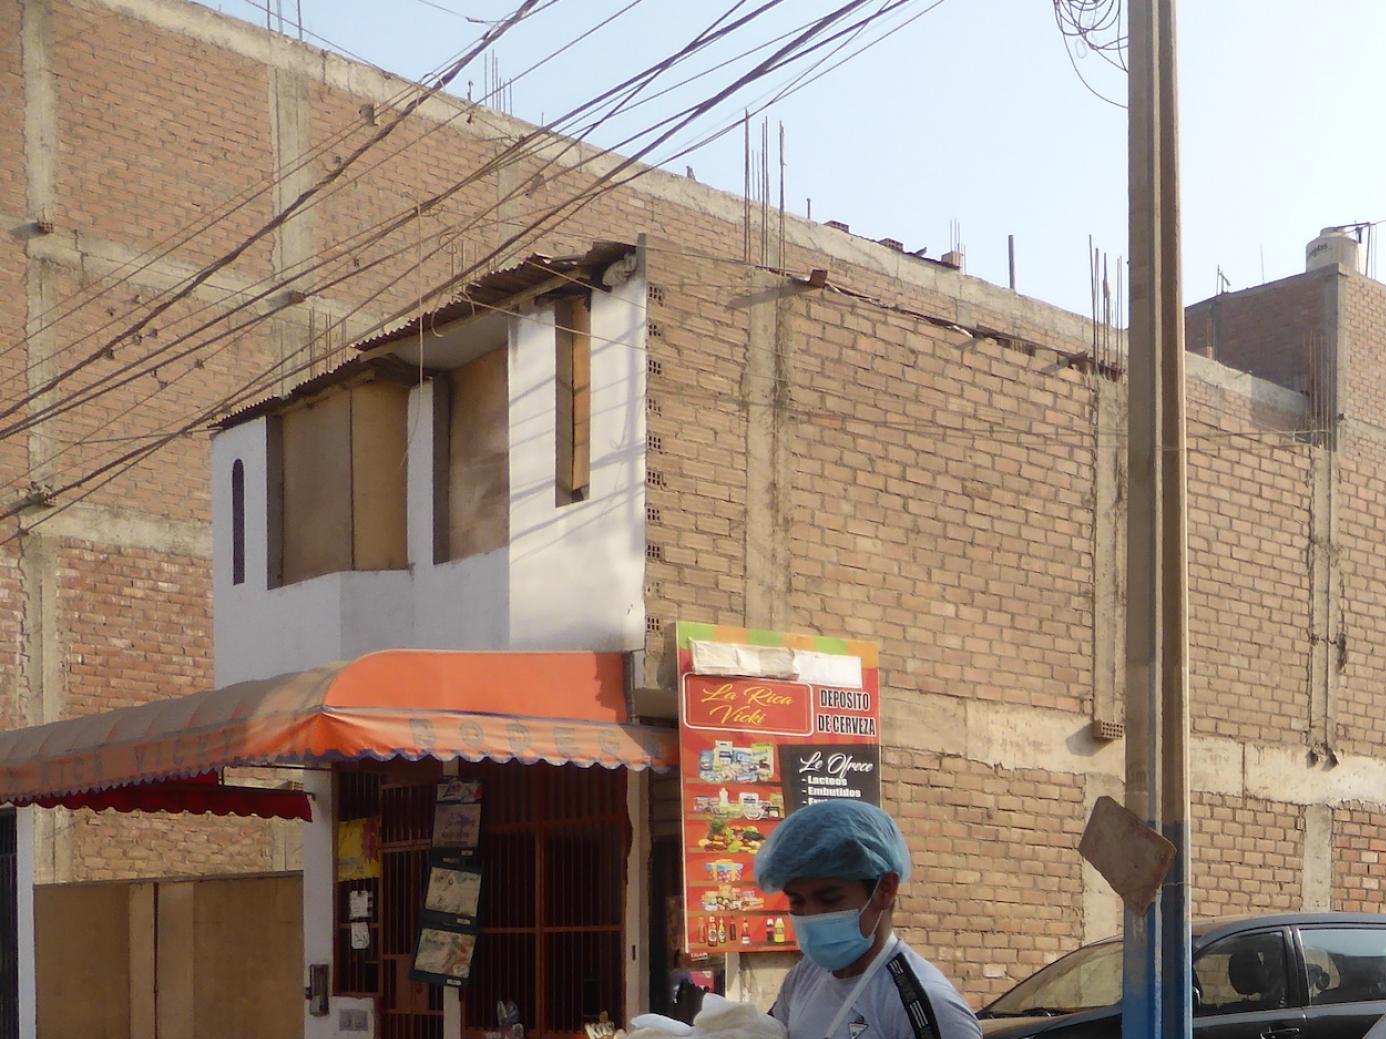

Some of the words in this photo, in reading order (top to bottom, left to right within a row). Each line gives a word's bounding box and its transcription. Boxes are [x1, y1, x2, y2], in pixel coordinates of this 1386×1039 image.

[702, 683, 737, 703] La
[743, 686, 793, 707] Rica
[819, 689, 869, 711] DEPOSITO
[709, 704, 767, 727] Vicki
[817, 715, 830, 733] DE
[832, 717, 876, 736] CERVEZA
[799, 751, 823, 774] Le
[827, 752, 874, 779] Ofrece
